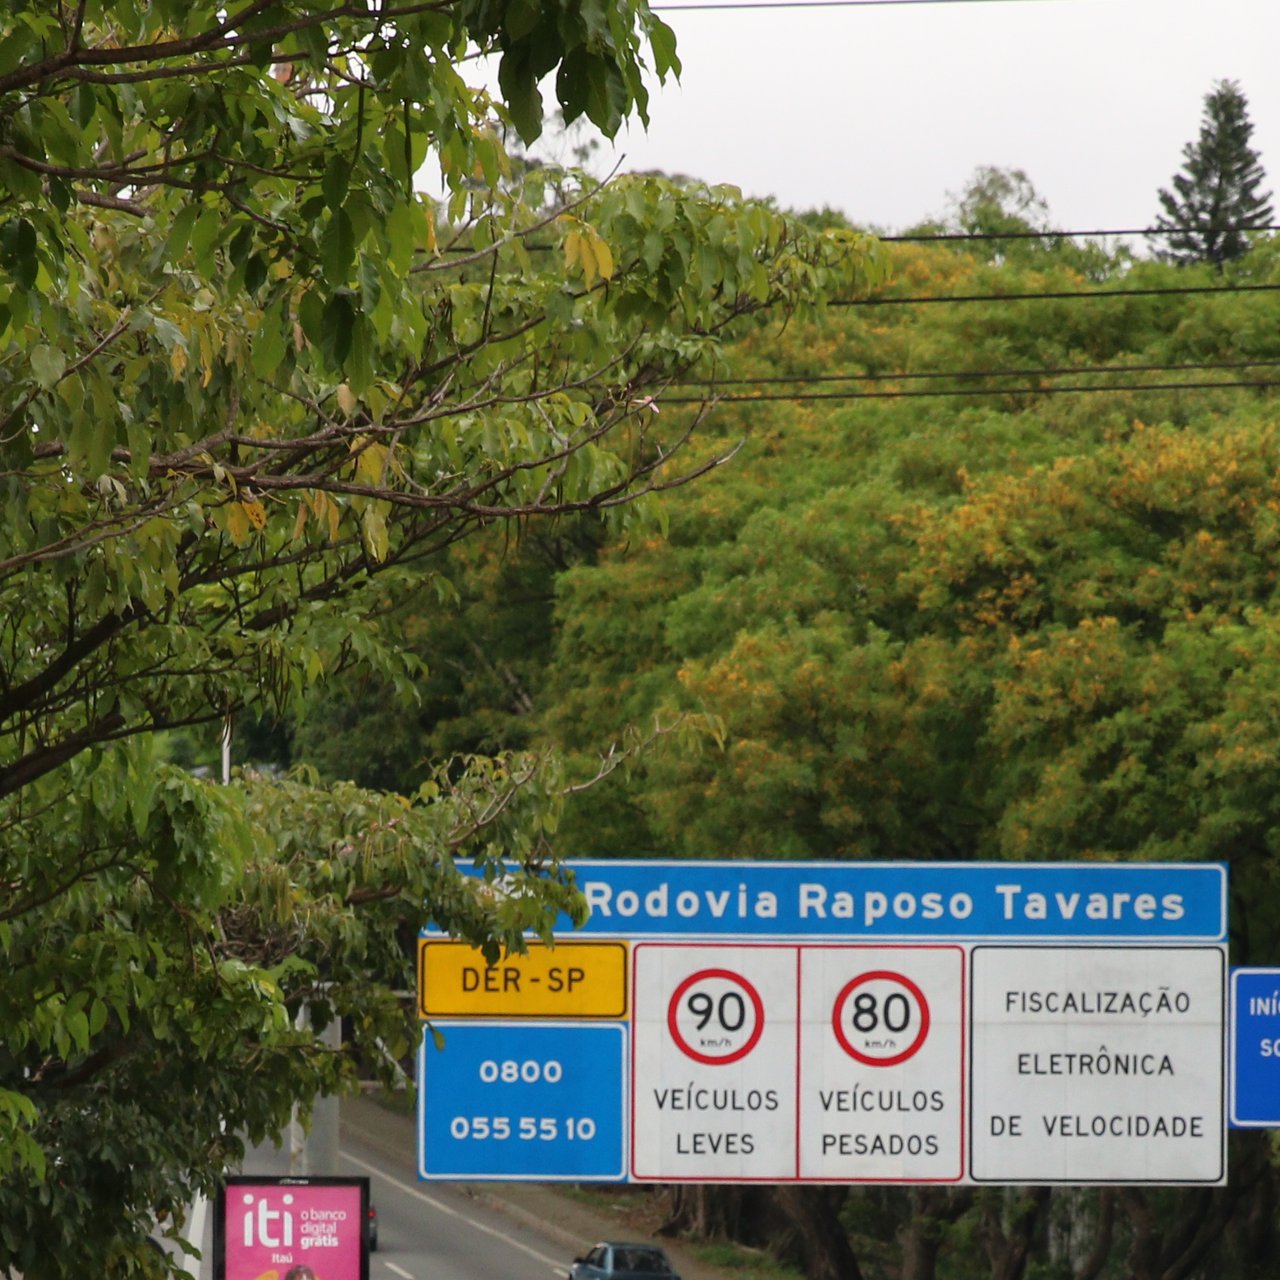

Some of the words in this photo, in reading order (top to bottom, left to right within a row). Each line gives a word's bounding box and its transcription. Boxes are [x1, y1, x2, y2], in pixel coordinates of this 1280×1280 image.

[585, 881, 778, 918] Rodovia
[799, 882, 973, 926] Raposo
[996, 884, 1186, 920] Tavares
[687, 992, 746, 1032] 90
[852, 993, 911, 1033] 80
[1006, 986, 1191, 1017] FISCALIZAÇÃO
[700, 1038, 732, 1048] km/h
[864, 1039, 897, 1049] km/h
[479, 1060, 563, 1083] 0800
[1018, 1045, 1174, 1076] ELETRÔNICA
[653, 1081, 780, 1111] VEÍCULOS
[819, 1082, 945, 1112] VEÍCULOS
[990, 1115, 1022, 1137] DE
[1042, 1115, 1204, 1138] VELOCIDADE
[676, 1133, 755, 1155] LEVES
[822, 1134, 939, 1156] PESADOS
[243, 1194, 294, 1248] iti
[301, 1211, 309, 1220] o
[310, 1208, 346, 1221] banco
[301, 1221, 337, 1237] digital
[272, 1252, 293, 1264] Itaú
